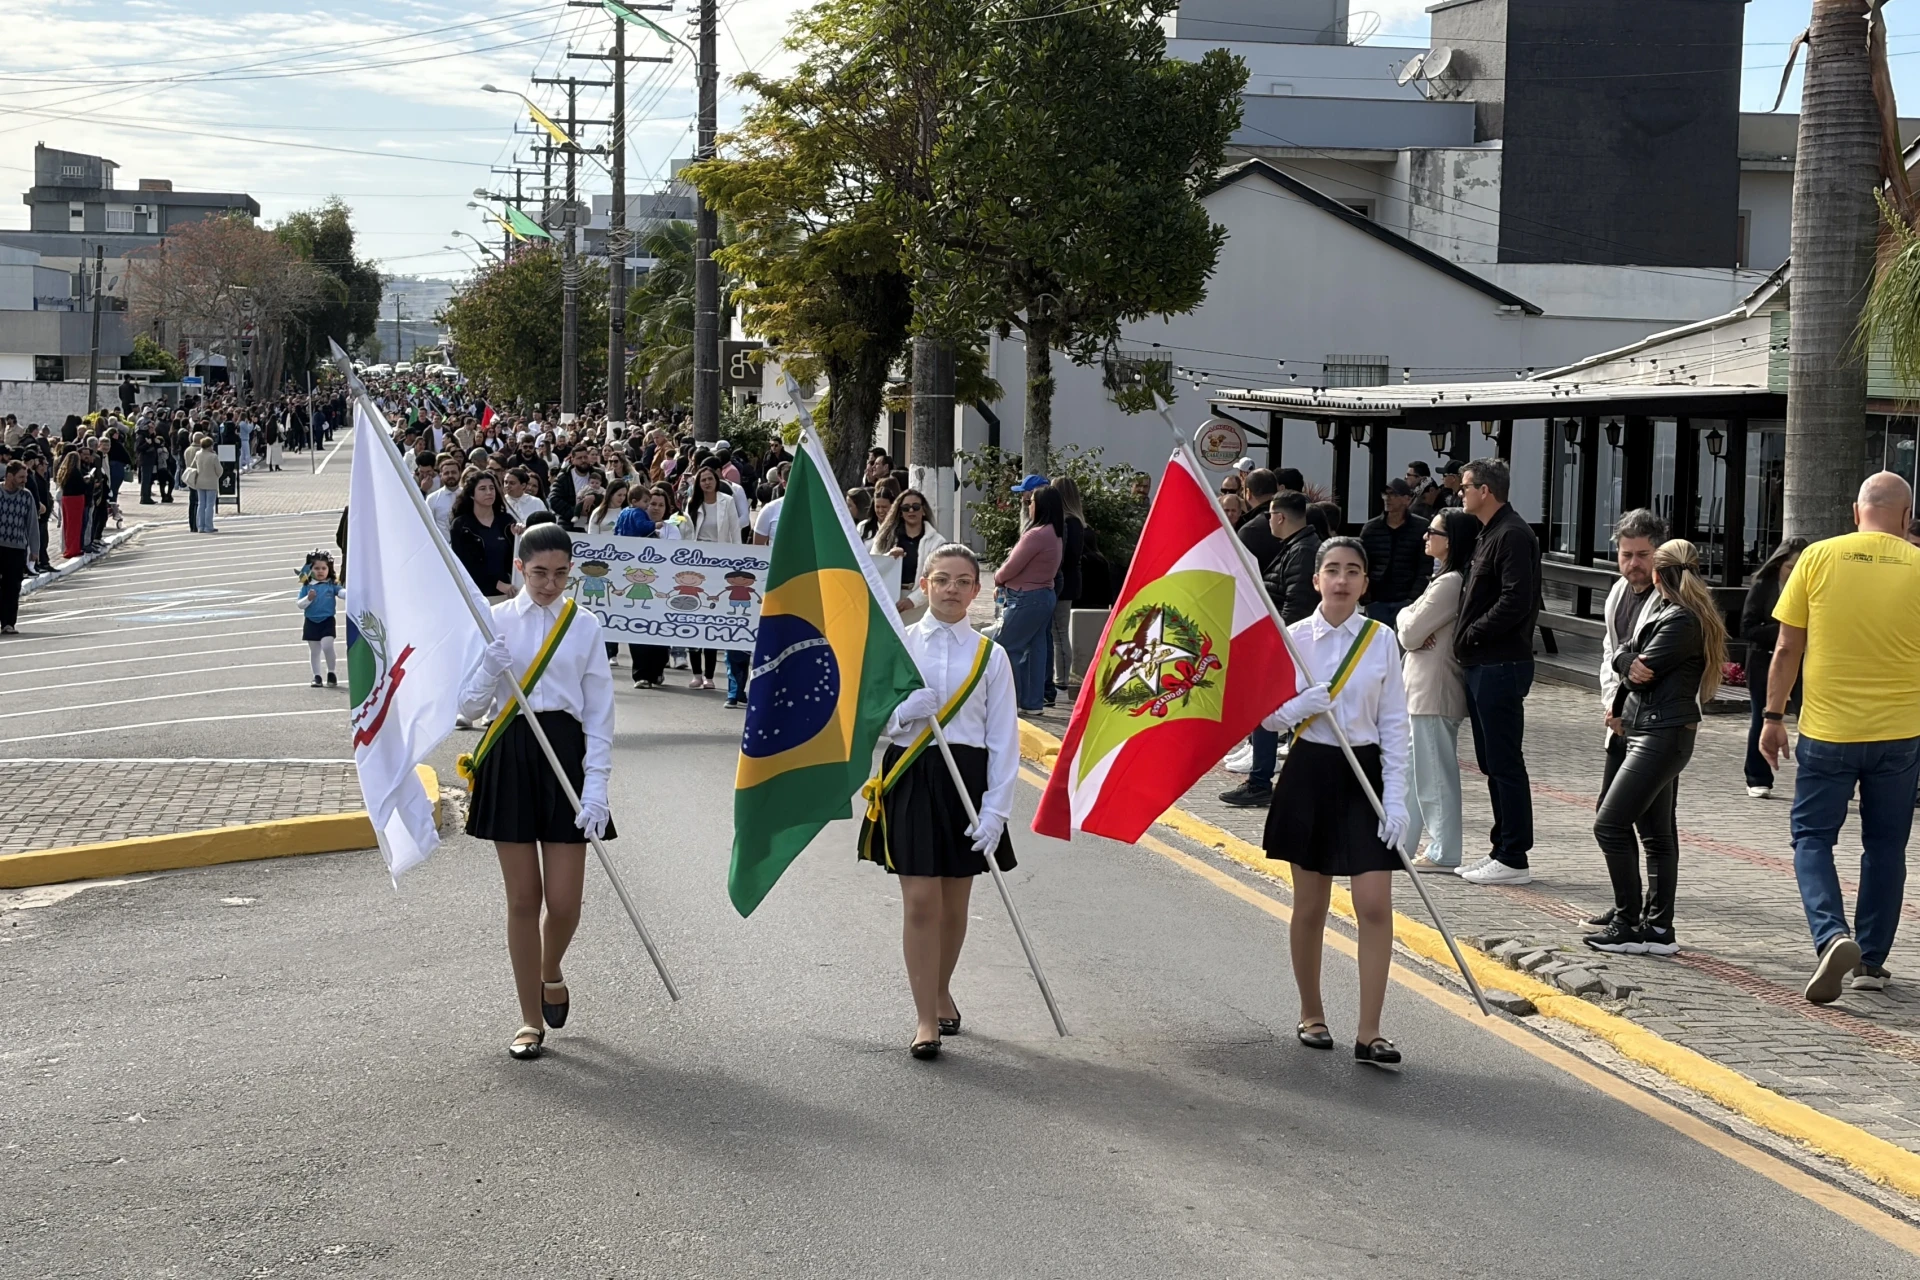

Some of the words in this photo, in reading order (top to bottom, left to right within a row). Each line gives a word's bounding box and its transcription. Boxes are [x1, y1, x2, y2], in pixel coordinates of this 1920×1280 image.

[572, 541, 635, 561] Centro
[638, 546, 667, 563] de
[670, 548, 770, 571] Educação
[587, 607, 699, 638] ARCISO
[705, 625, 759, 642] MA
[664, 612, 749, 627] VEREADOR
